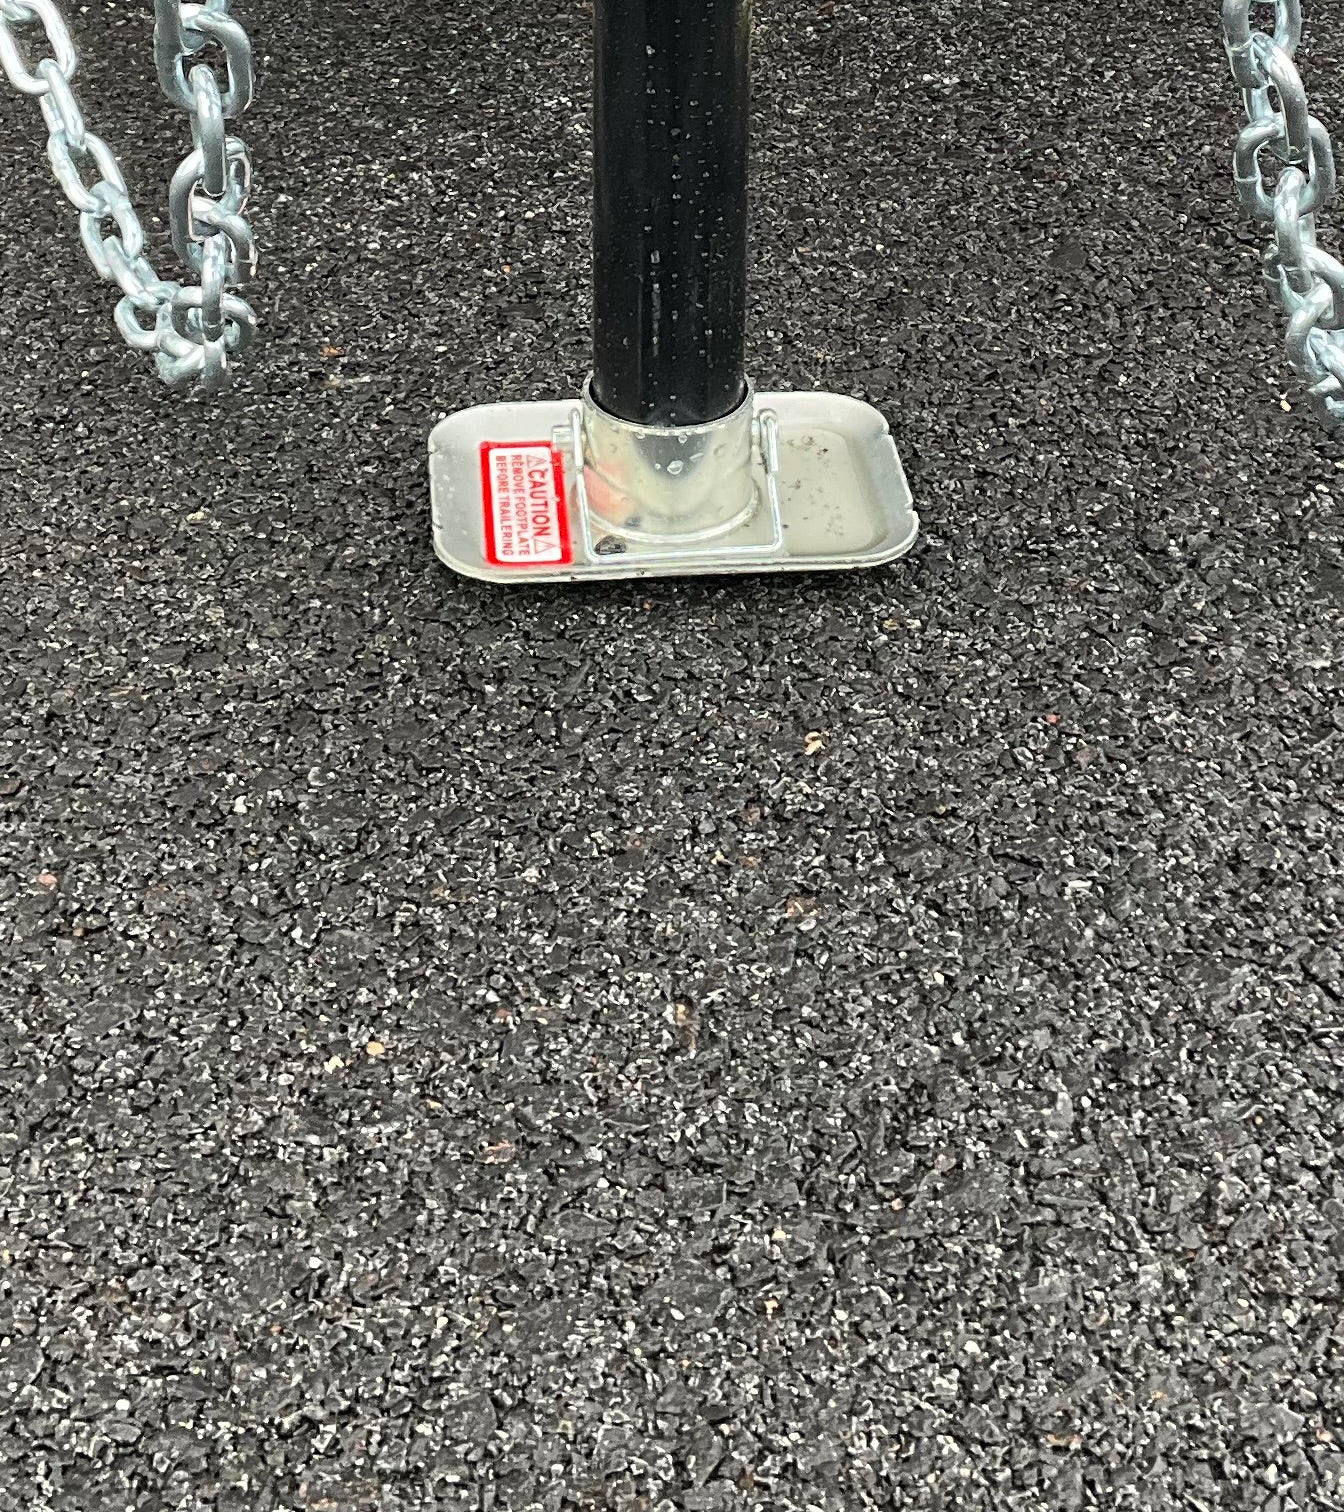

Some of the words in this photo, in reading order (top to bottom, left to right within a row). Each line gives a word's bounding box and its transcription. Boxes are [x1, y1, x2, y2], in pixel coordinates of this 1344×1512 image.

[495, 455, 510, 494] BEFORE
[510, 454, 526, 495] REMOVE
[527, 468, 551, 537] CAUTION
[498, 495, 515, 557] TRAILERING
[514, 494, 531, 556] FOOTPLATE
